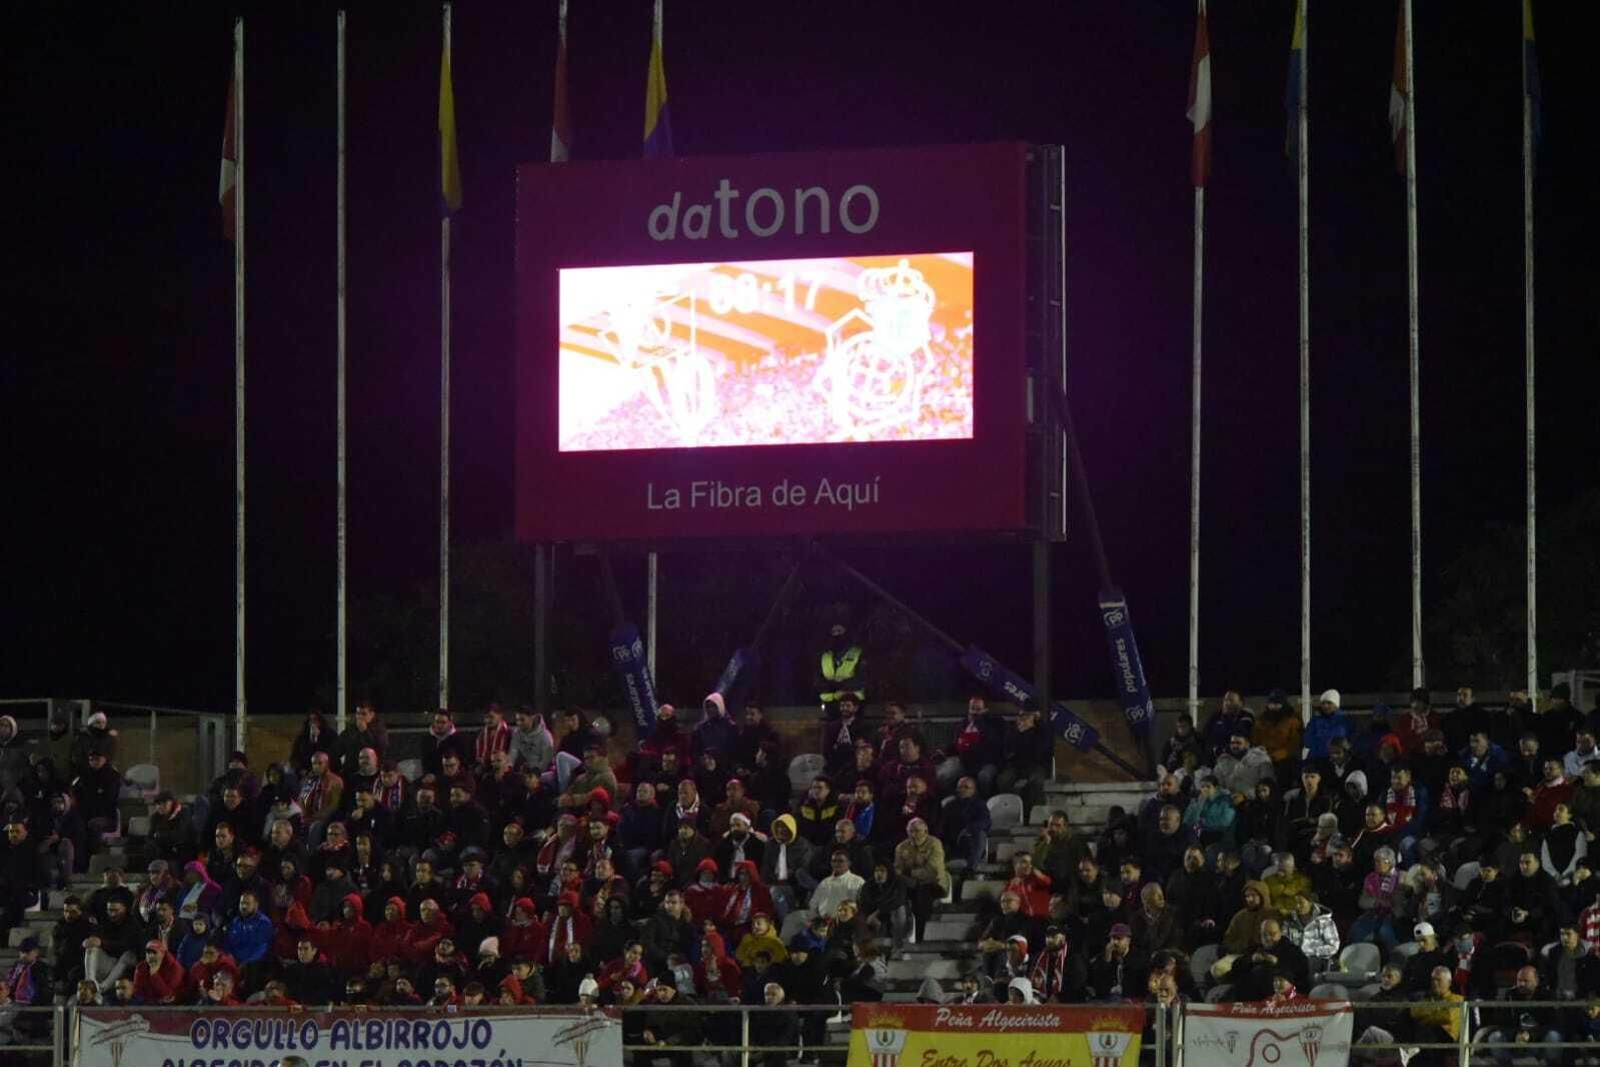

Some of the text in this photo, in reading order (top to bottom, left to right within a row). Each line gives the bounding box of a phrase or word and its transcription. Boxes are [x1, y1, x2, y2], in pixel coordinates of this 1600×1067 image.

[648, 179, 880, 241] datono
[647, 476, 880, 511] La Fibra de Aquí
[1115, 638, 1138, 693] populares
[191, 1018, 492, 1050] ORGULLO ALBIRROJO
[935, 1007, 1062, 1032] Peña Algecirista
